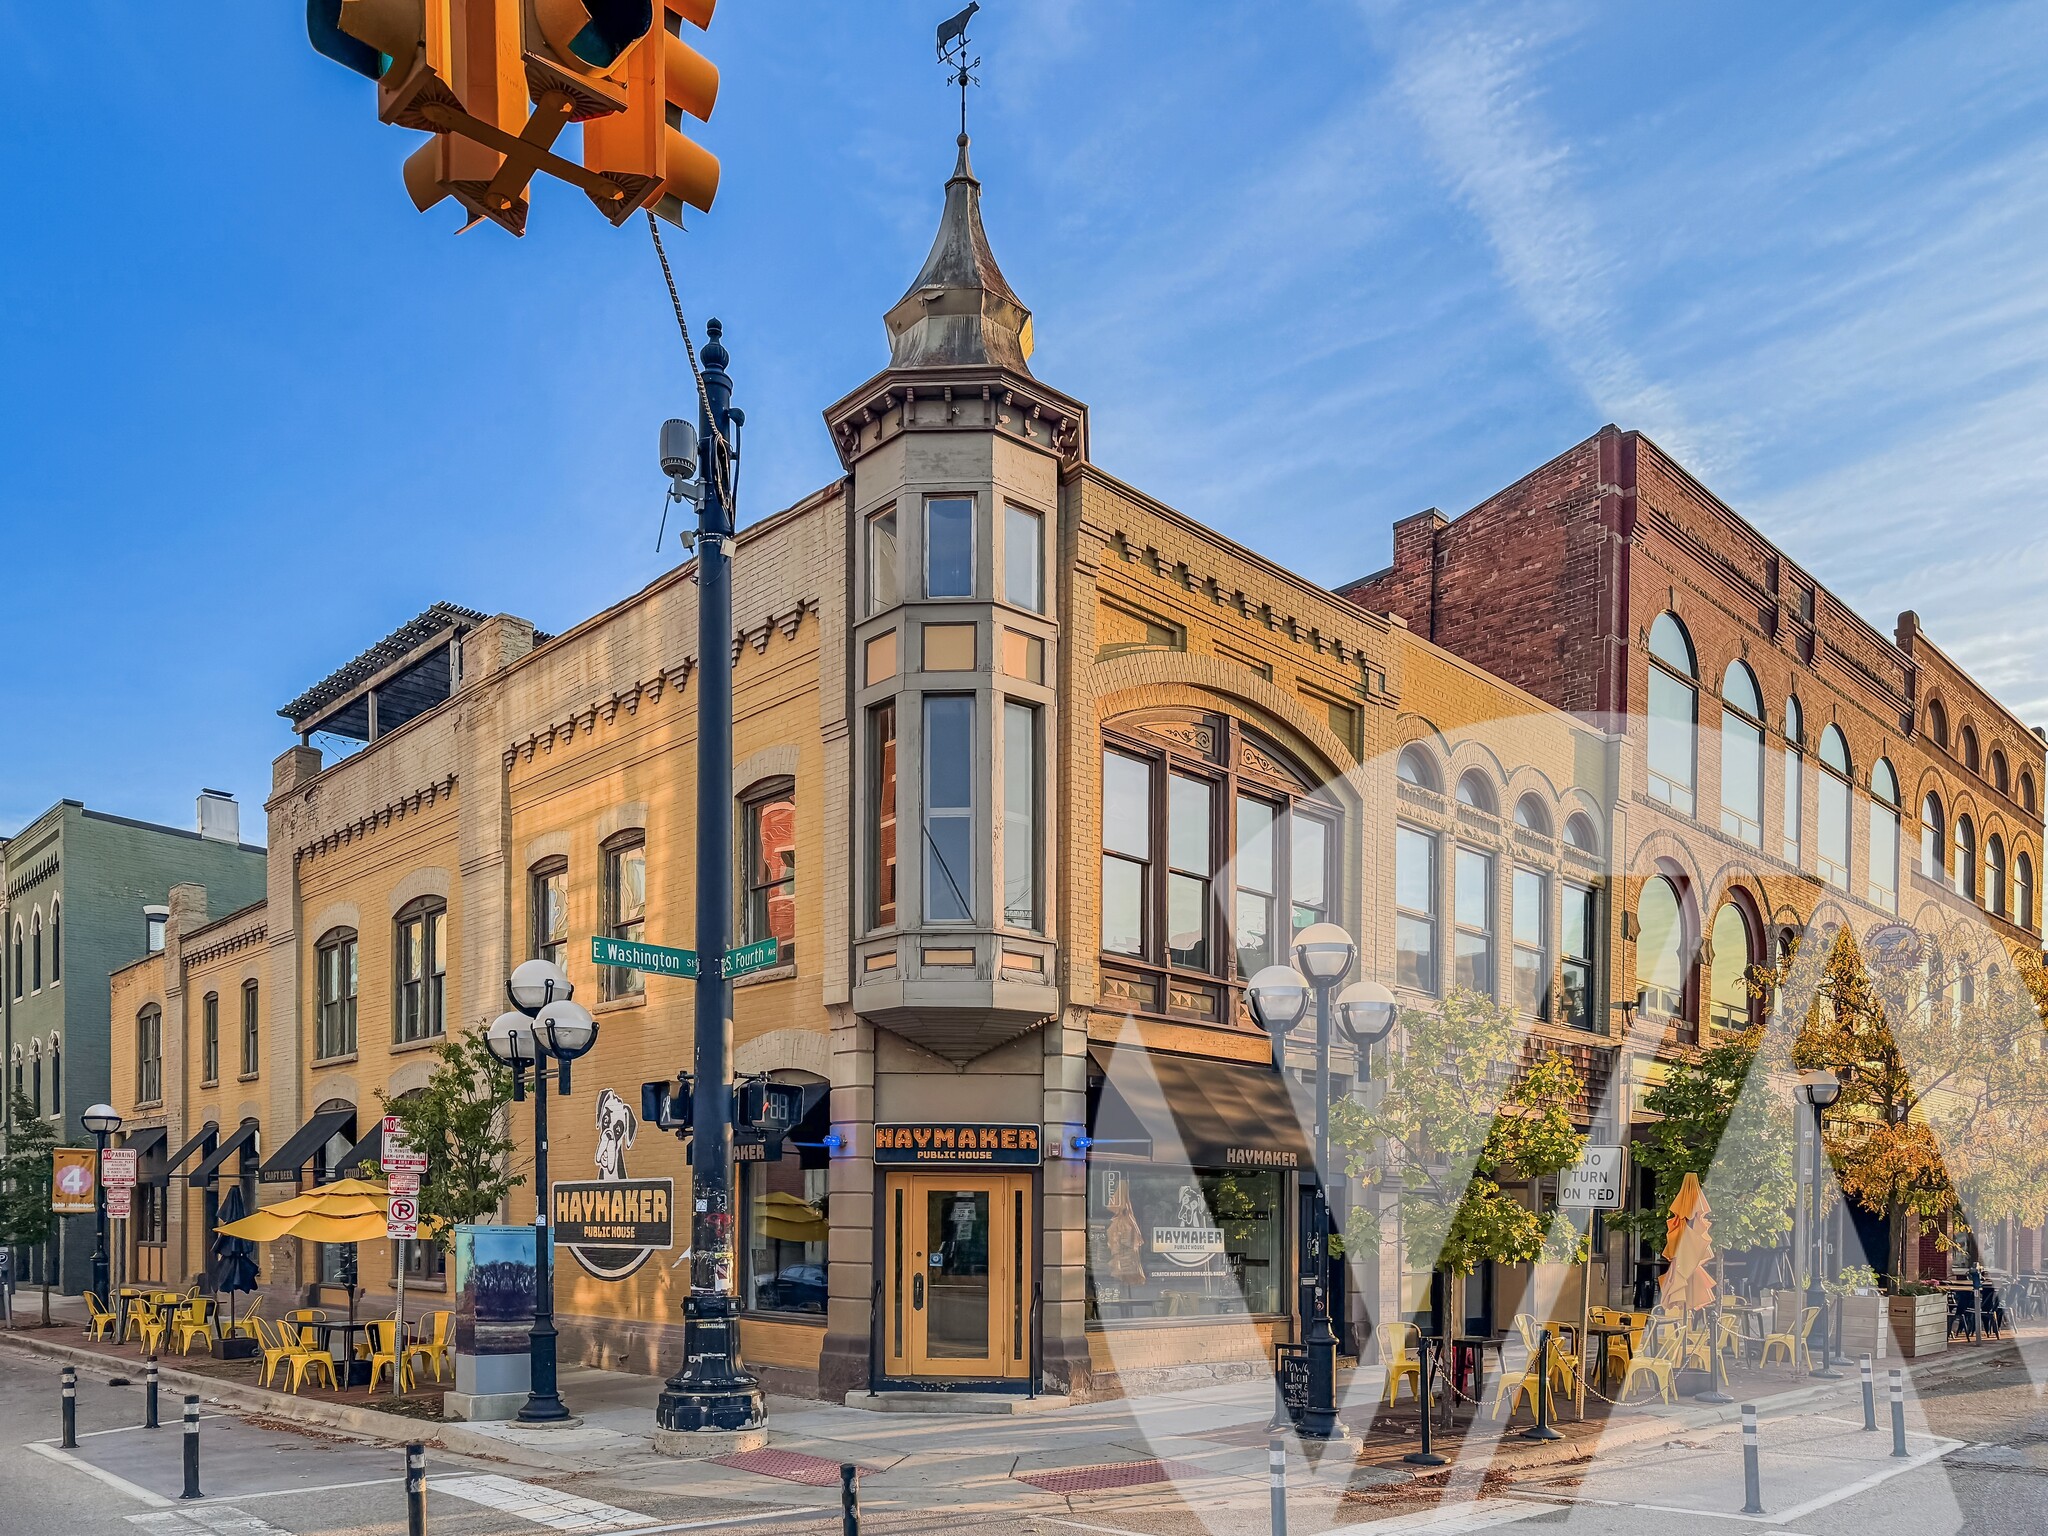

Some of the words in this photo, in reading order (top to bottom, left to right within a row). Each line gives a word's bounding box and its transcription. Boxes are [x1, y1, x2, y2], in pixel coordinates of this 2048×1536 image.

[593, 941, 605, 959] E.
[607, 943, 680, 971] Washington
[726, 955, 733, 971] S.
[735, 947, 764, 969] Fourth
[767, 947, 776, 957] Ave
[384, 1120, 395, 1130] NO
[875, 1128, 1038, 1150] HAYMAKER
[733, 1144, 765, 1160] AKER
[917, 1151, 956, 1160] PUBLIC
[957, 1151, 993, 1160] HOUSE
[1226, 1148, 1298, 1167] HAYMAKER
[1583, 1154, 1602, 1166] NO
[62, 1168, 83, 1192] 4
[280, 1170, 293, 1180] BEER
[1571, 1171, 1608, 1183] TURN
[1107, 1172, 1116, 1206] OPEN
[1563, 1187, 1581, 1200] ON
[1588, 1188, 1615, 1201] RED
[556, 1189, 668, 1223] HAYMAKER
[583, 1226, 611, 1238] PUBLIC
[611, 1226, 636, 1239] HOUSE
[1155, 1230, 1223, 1244] HAYMAKER
